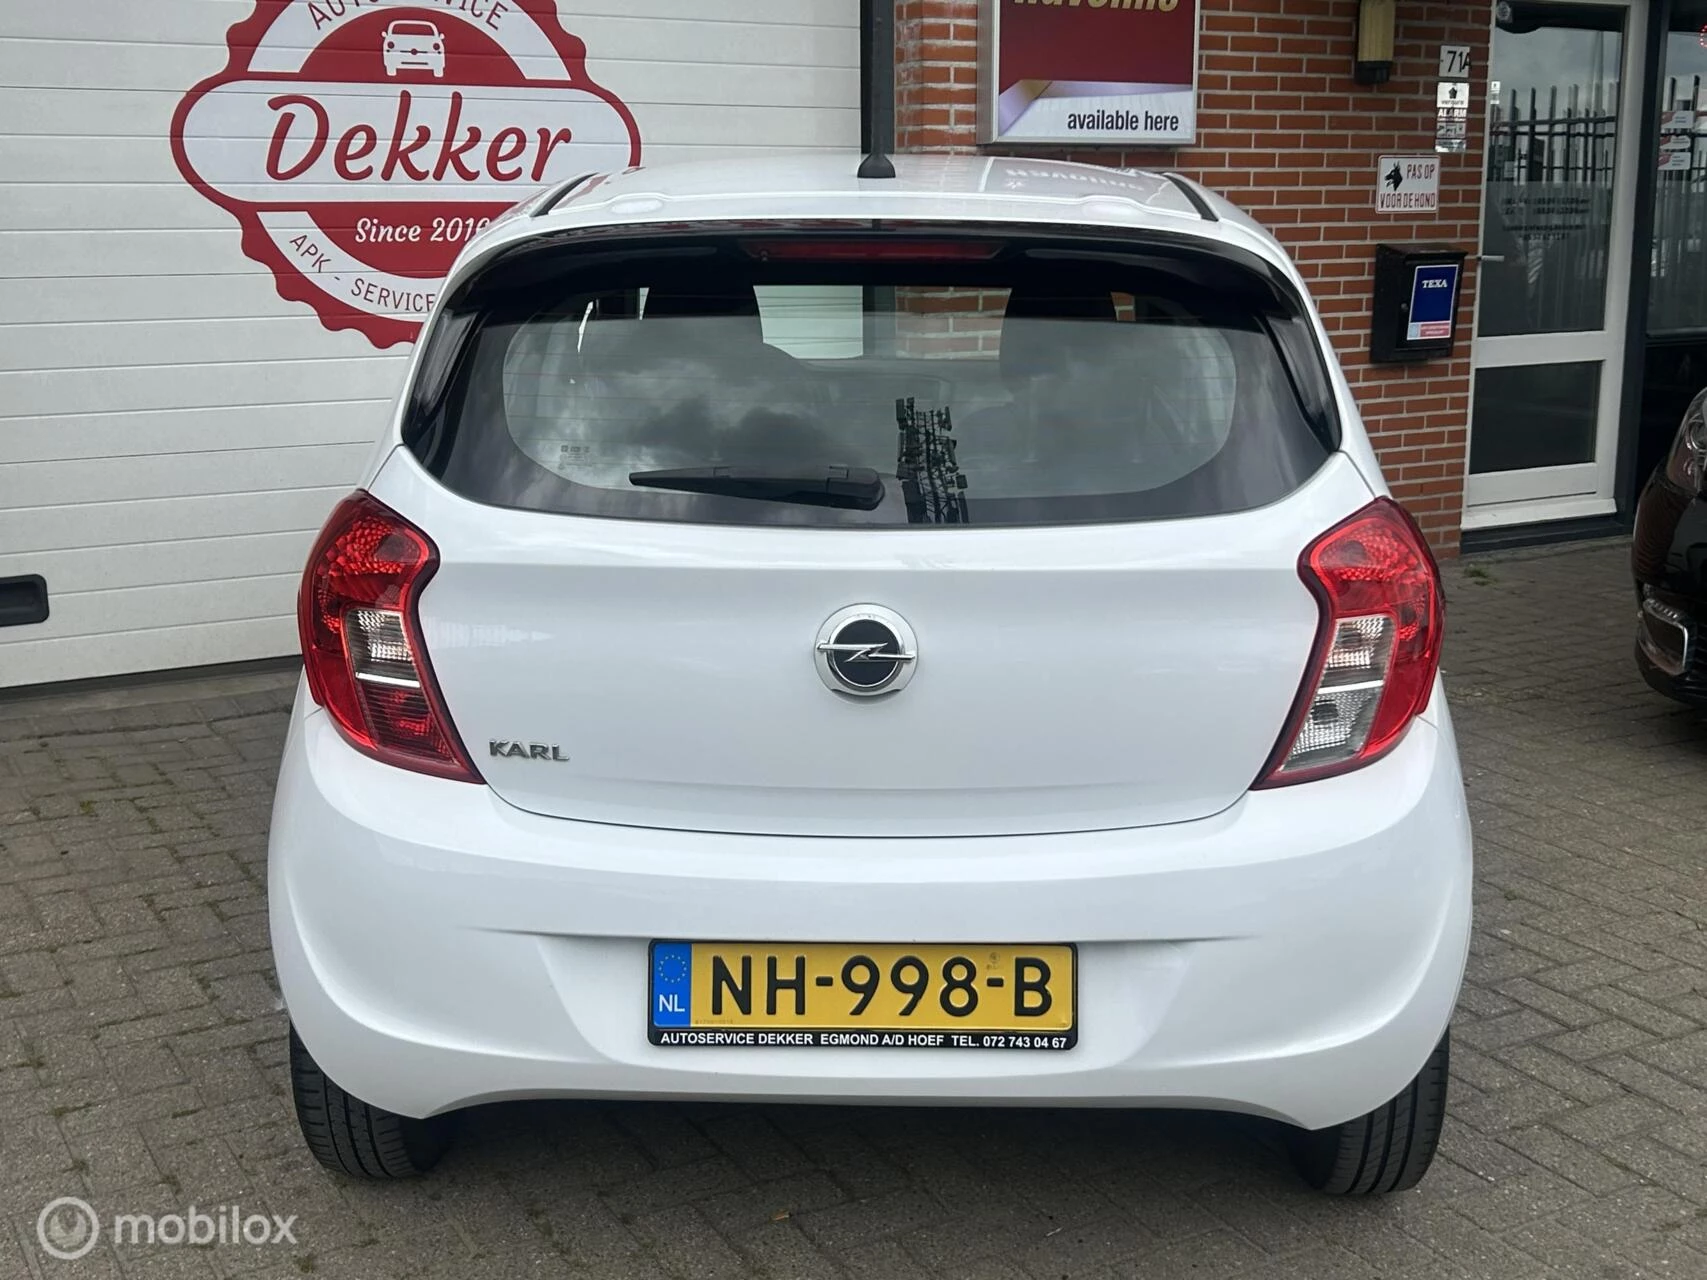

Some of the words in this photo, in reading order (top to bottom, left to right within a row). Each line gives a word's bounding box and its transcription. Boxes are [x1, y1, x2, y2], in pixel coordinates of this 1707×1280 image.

[1067, 109, 1139, 131] available
[1144, 110, 1179, 131] here
[1437, 108, 1467, 118] ALARM
[266, 90, 571, 182] Dekker
[1407, 164, 1422, 180] PAS
[1424, 164, 1435, 180] OP
[1380, 193, 1402, 209] VOOR
[1403, 193, 1413, 208] DE
[1414, 193, 1436, 208] HOND
[355, 217, 422, 242] Since
[289, 234, 334, 274] APK
[1421, 279, 1448, 289] TEXA
[489, 740, 570, 762] KARL
[711, 954, 1053, 1017] NH-998-B
[658, 993, 685, 1013] NL
[660, 1032, 755, 1045] AUTOSERVICE
[758, 1033, 814, 1045] DEKKER
[820, 1034, 879, 1046] EGMOND
[882, 1034, 905, 1047] A/D
[908, 1034, 945, 1047] HOEF
[951, 1034, 980, 1048] TEL.
[983, 1035, 1005, 1048] 072
[1008, 1036, 1030, 1048] 743
[1033, 1036, 1049, 1048] 04
[1051, 1037, 1067, 1049] 67
